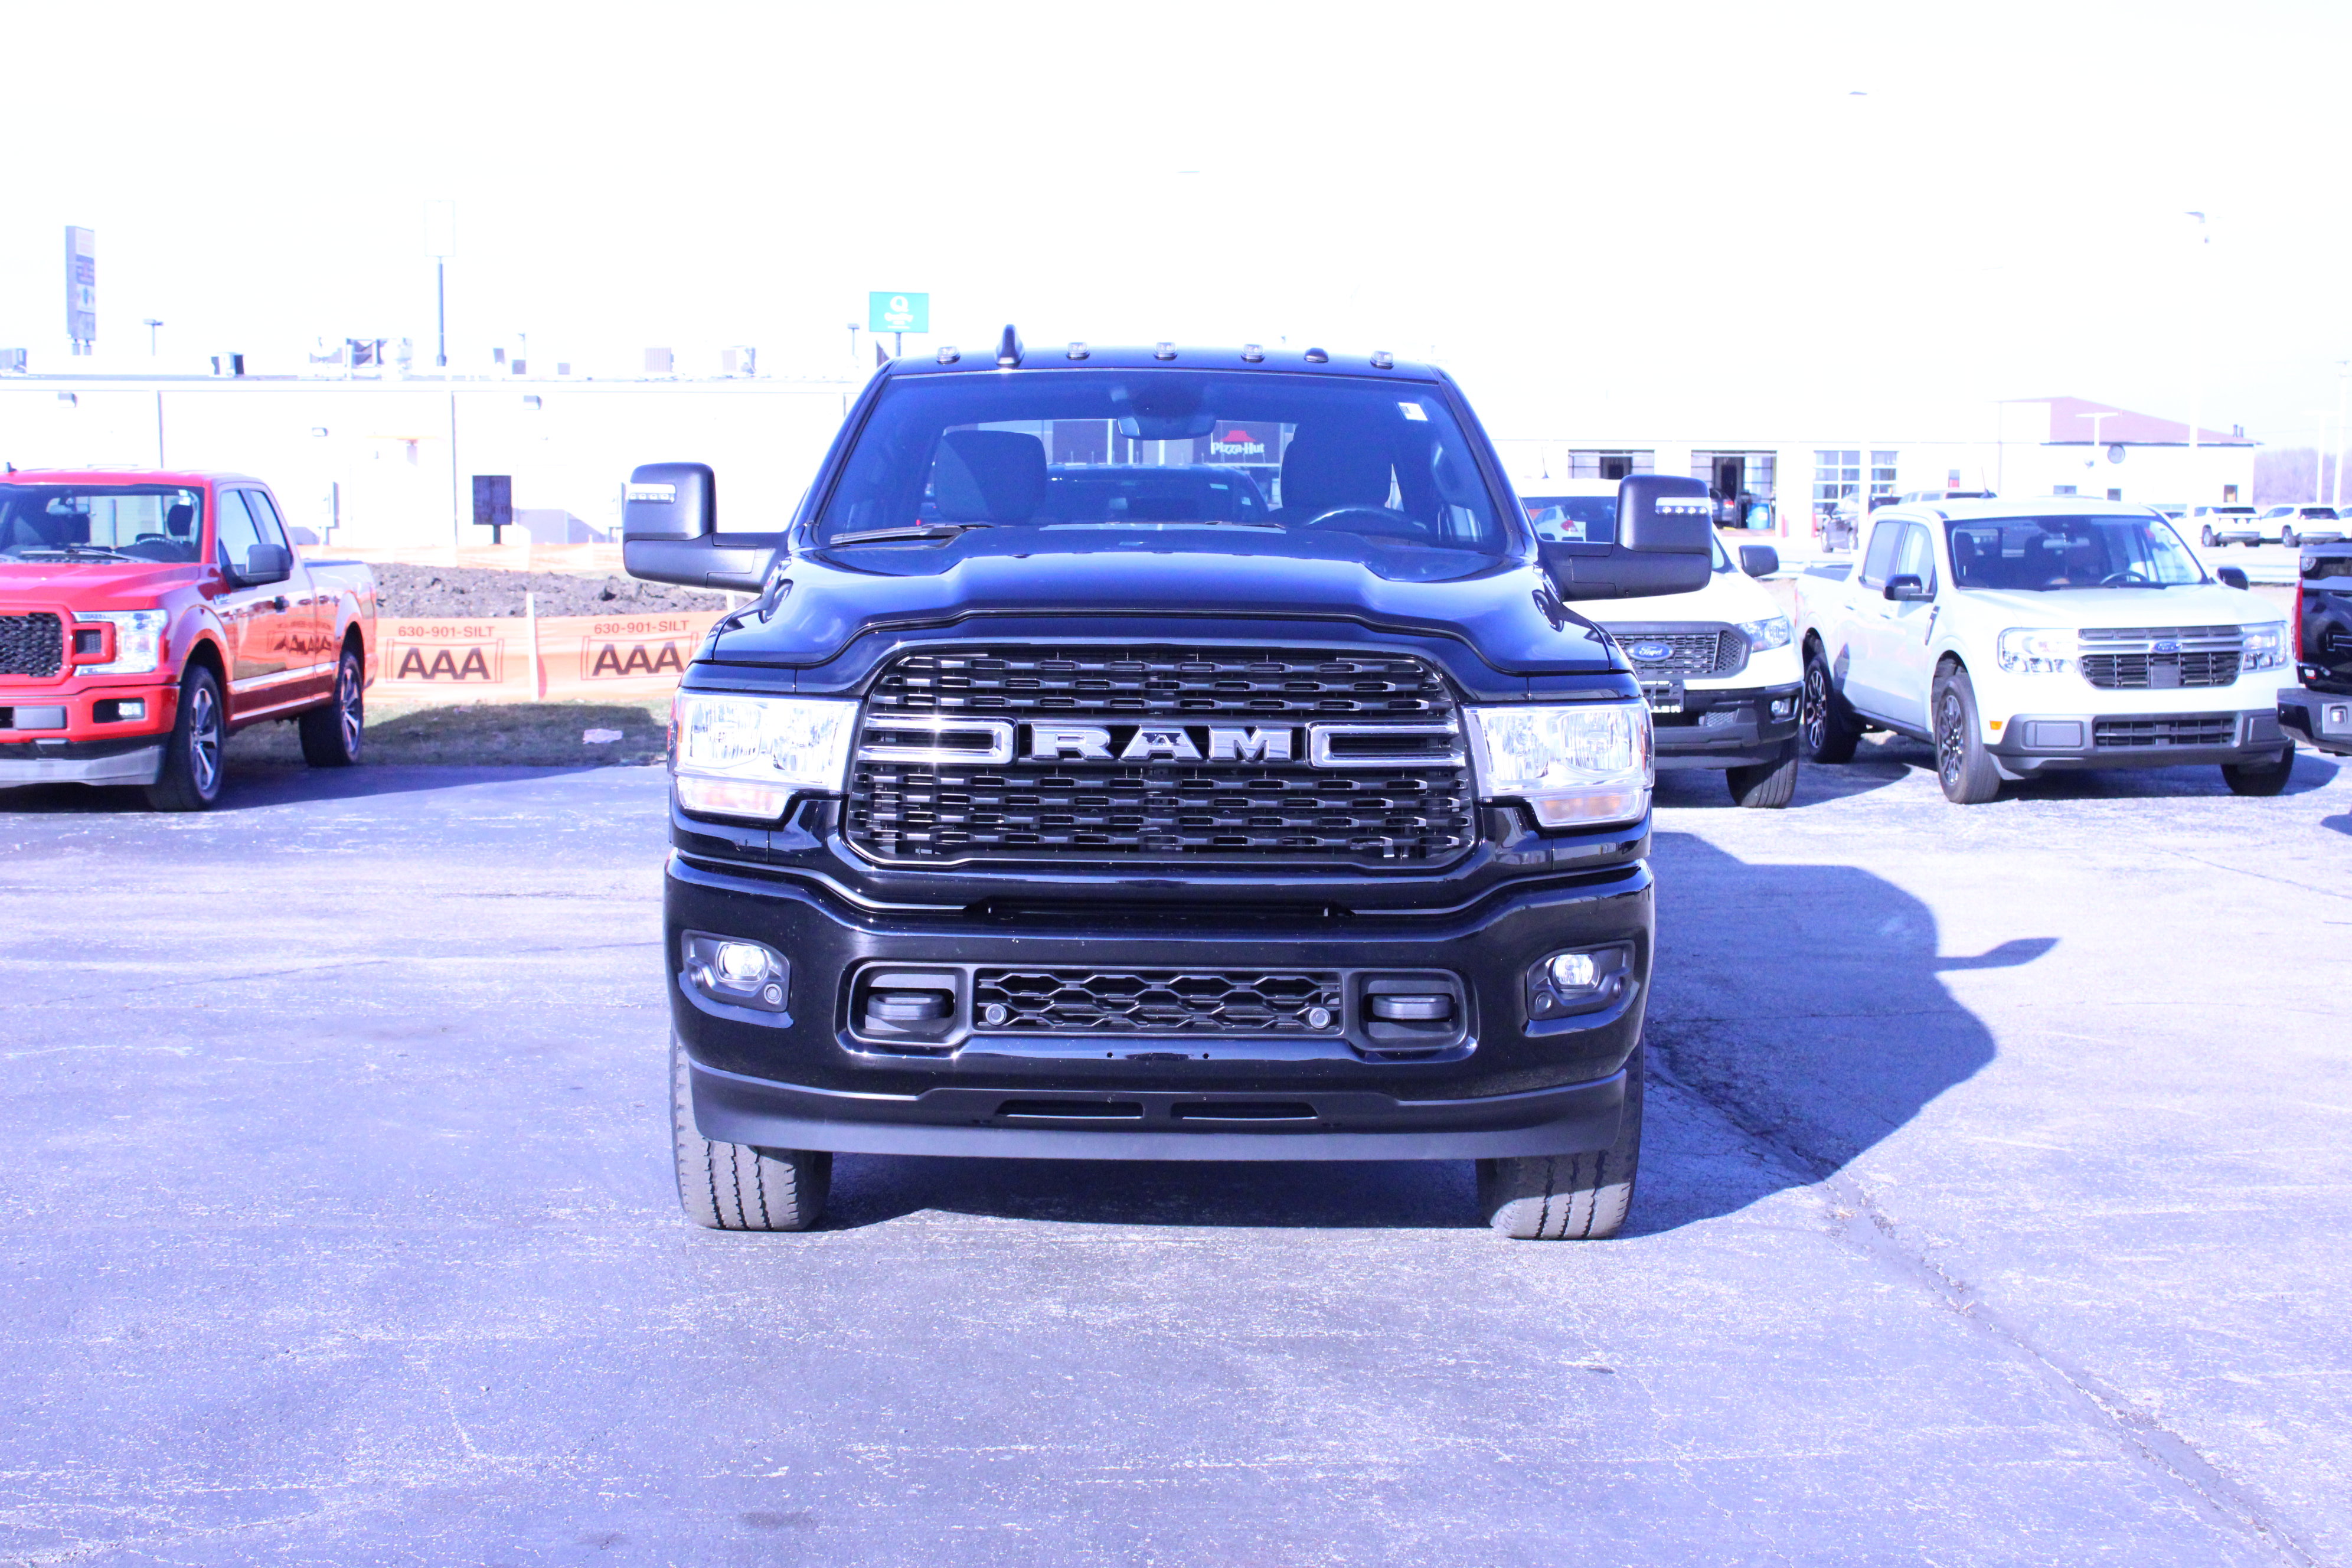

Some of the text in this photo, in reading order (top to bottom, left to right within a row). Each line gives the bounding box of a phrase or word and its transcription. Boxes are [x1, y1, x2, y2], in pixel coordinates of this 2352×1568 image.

[1211, 442, 1265, 455] Pizza Hut
[398, 626, 495, 638] 630-901-SILT
[594, 620, 690, 634] 630-901-SILT
[592, 640, 684, 676] AAA
[1639, 646, 1663, 656] Ford
[397, 646, 491, 680] AAA
[1031, 723, 1293, 762] RAM
